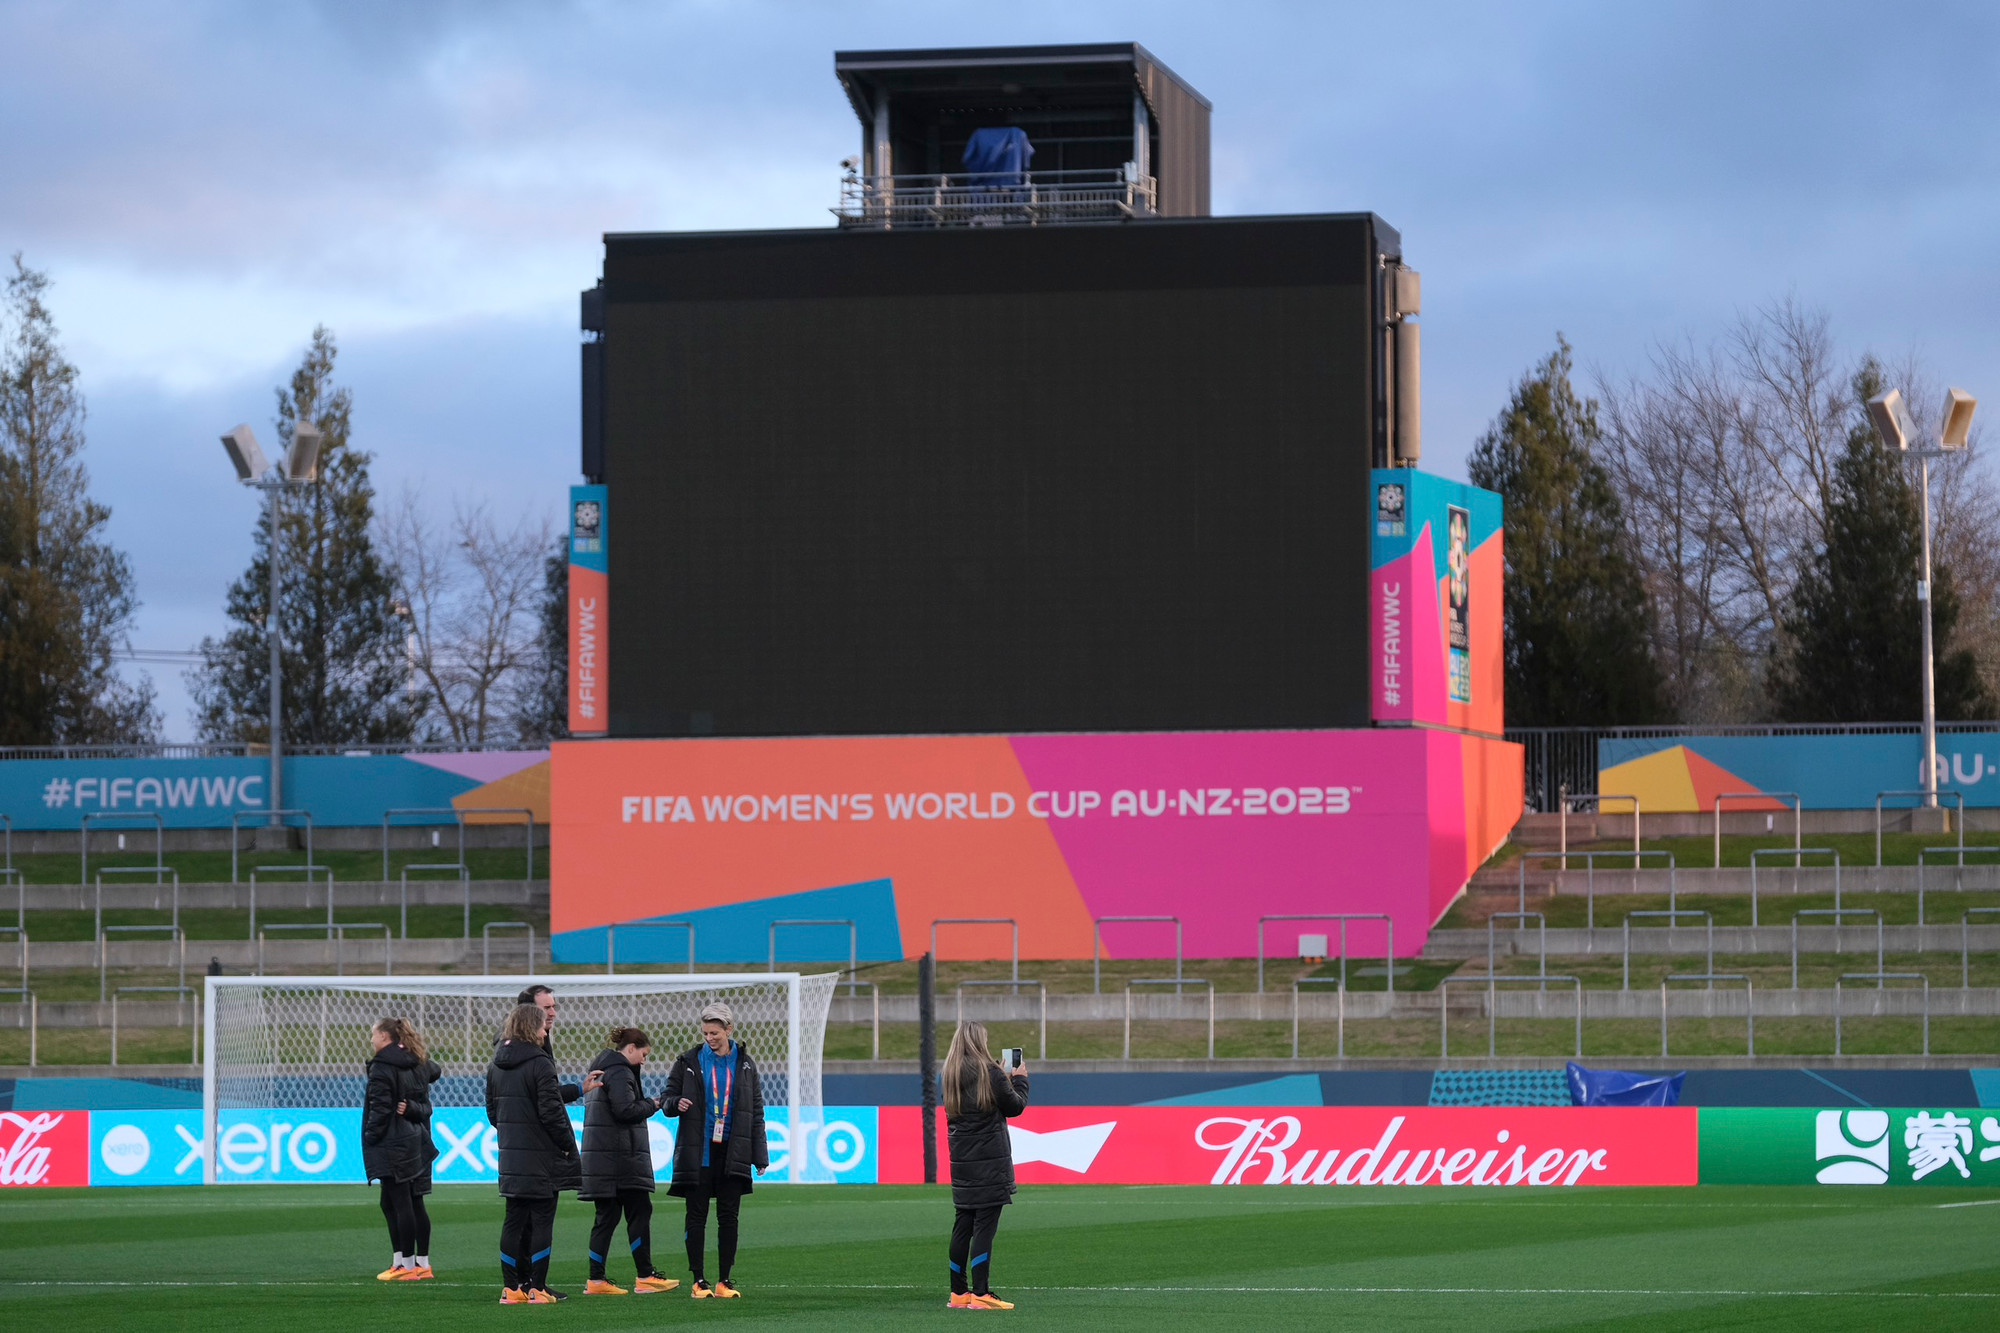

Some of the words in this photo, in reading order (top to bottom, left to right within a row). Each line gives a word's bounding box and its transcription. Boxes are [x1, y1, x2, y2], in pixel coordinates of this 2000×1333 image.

[579, 596, 596, 719] #FIFAWWC
[1383, 581, 1401, 707] #FIFAWWC
[42, 775, 263, 809] #FIFAWWC
[621, 795, 696, 823] FIFA
[701, 793, 874, 823] WOMEN'S
[884, 791, 1017, 821] WORLD
[1026, 790, 1102, 819] CUP
[174, 1122, 337, 1175] xero
[765, 1120, 866, 1173] ero
[1194, 1115, 1608, 1185] Budweiser
